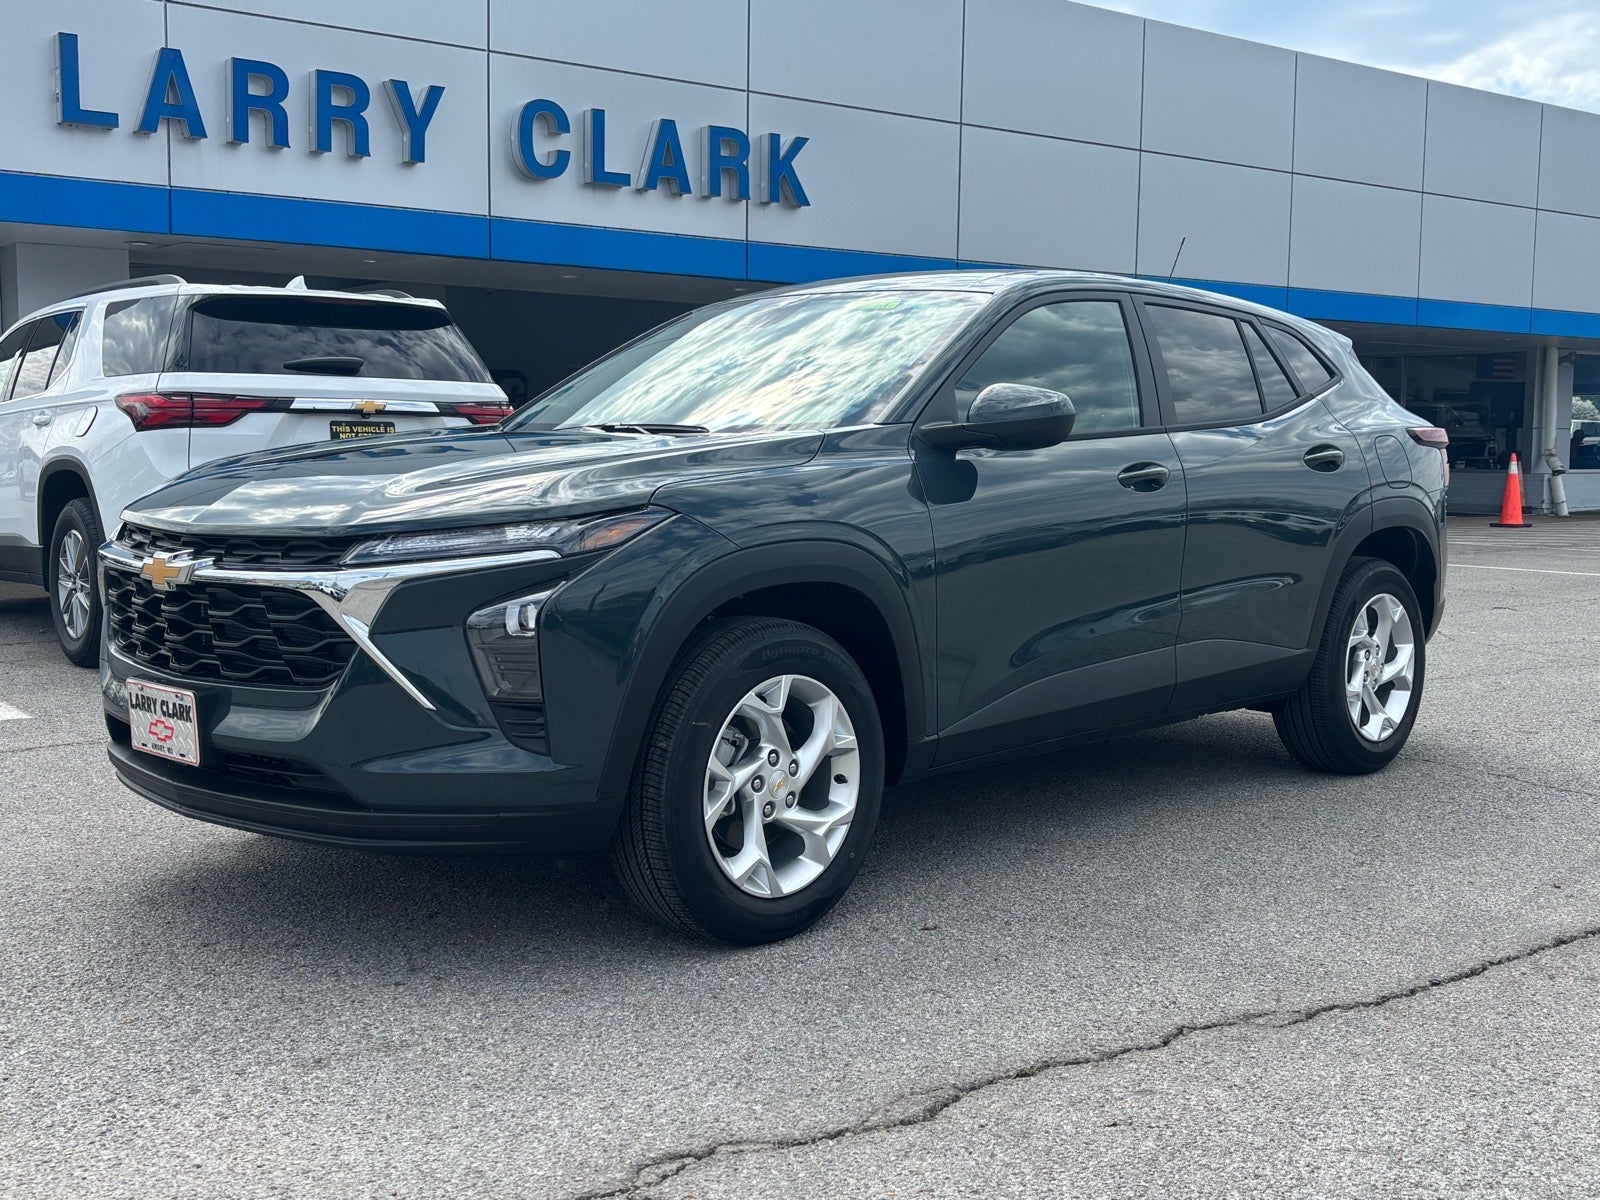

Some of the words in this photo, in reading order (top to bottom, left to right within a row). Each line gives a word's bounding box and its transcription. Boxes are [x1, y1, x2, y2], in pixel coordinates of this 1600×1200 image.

[54, 32, 446, 164] LARRY
[511, 98, 812, 208] CLARK
[331, 425, 350, 433] THIS
[387, 426, 395, 434] IS
[129, 692, 157, 714] LARRY
[160, 699, 192, 723] CLARK
